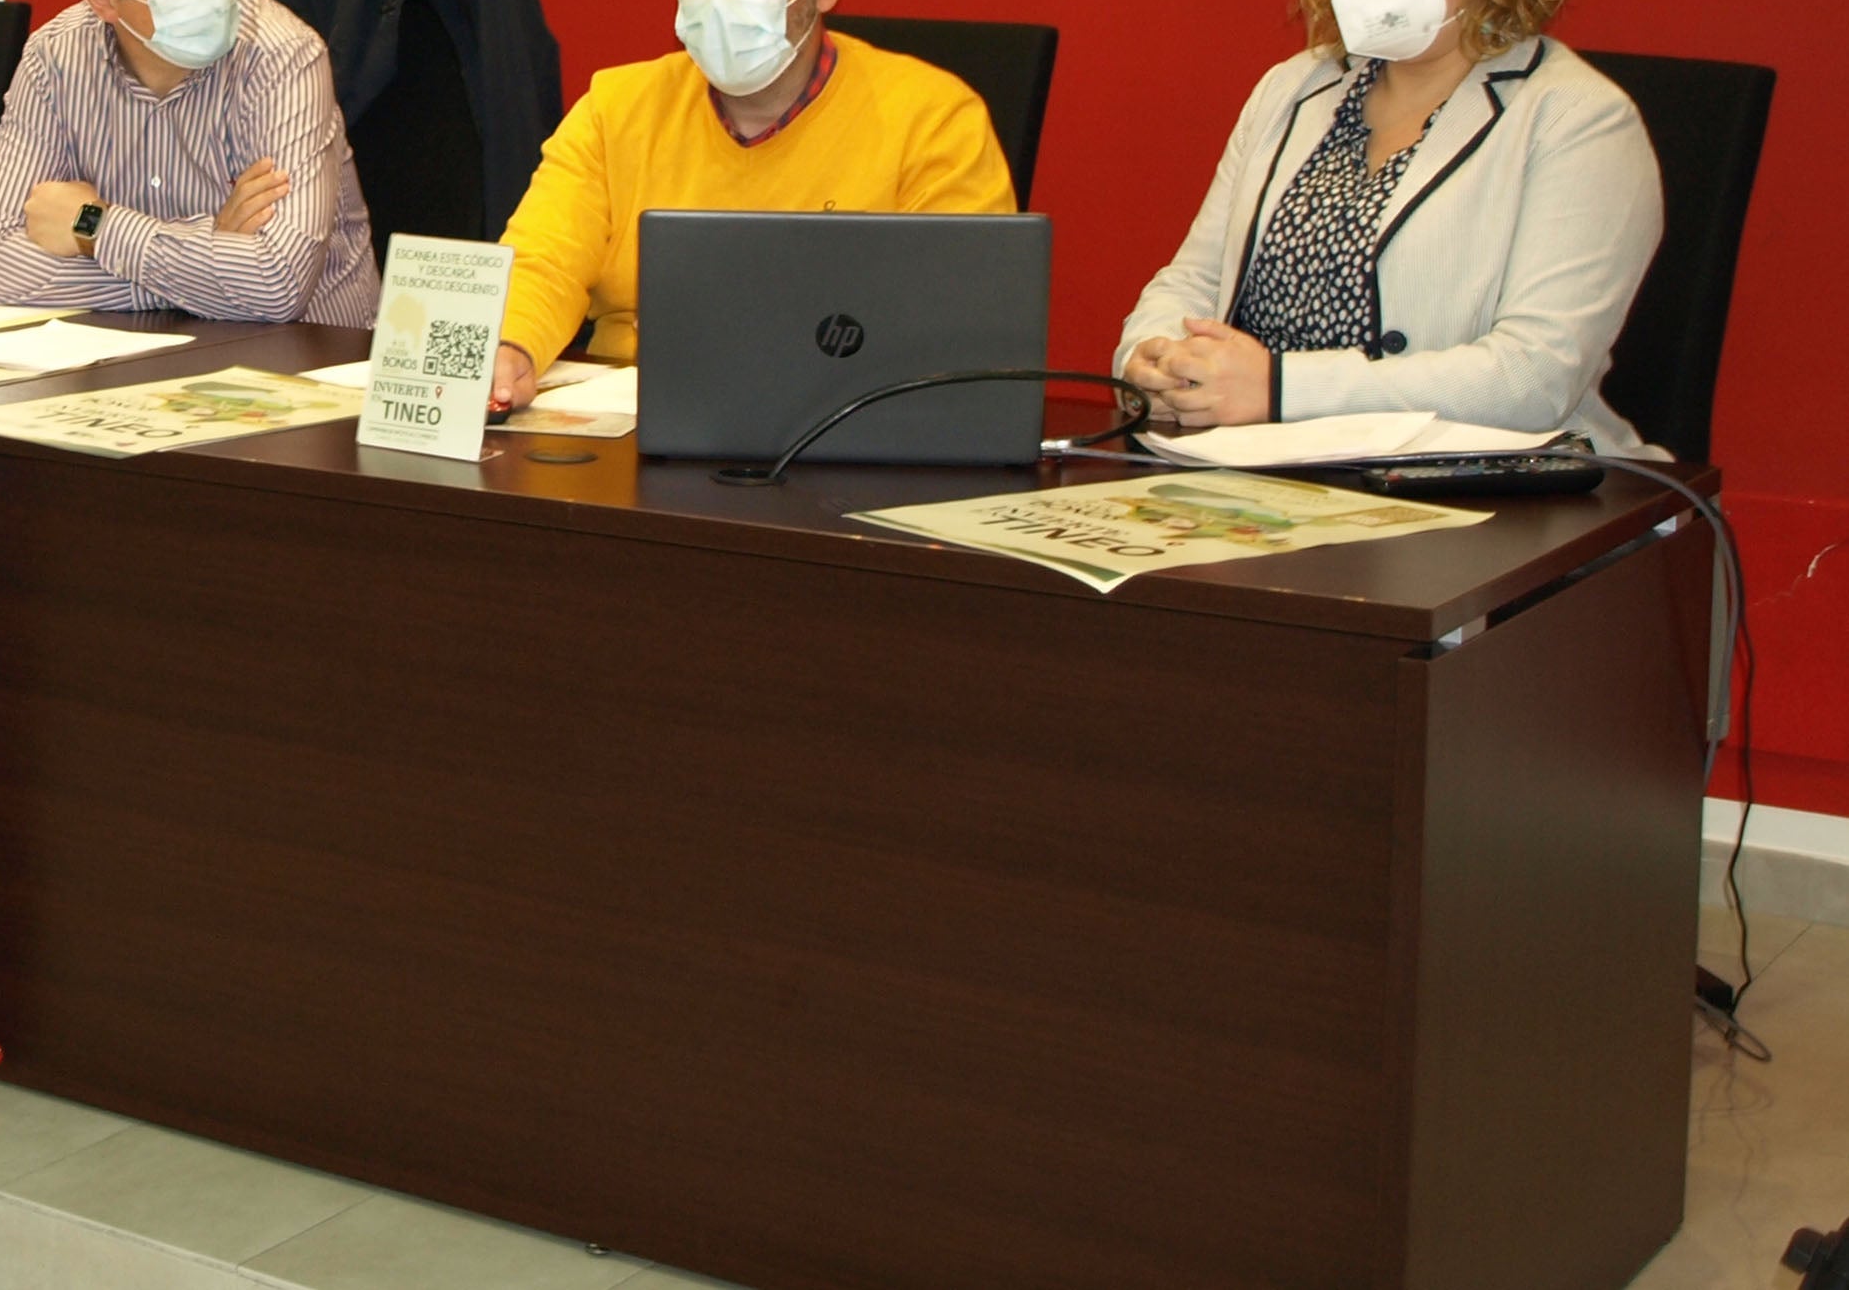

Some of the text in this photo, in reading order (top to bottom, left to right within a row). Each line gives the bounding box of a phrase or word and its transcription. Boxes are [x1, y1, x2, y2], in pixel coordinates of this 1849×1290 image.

[382, 356, 418, 370] BONOS
[373, 380, 430, 398] INVIERTE
[382, 400, 442, 425] TINEO
[980, 514, 1166, 557] TINEO
